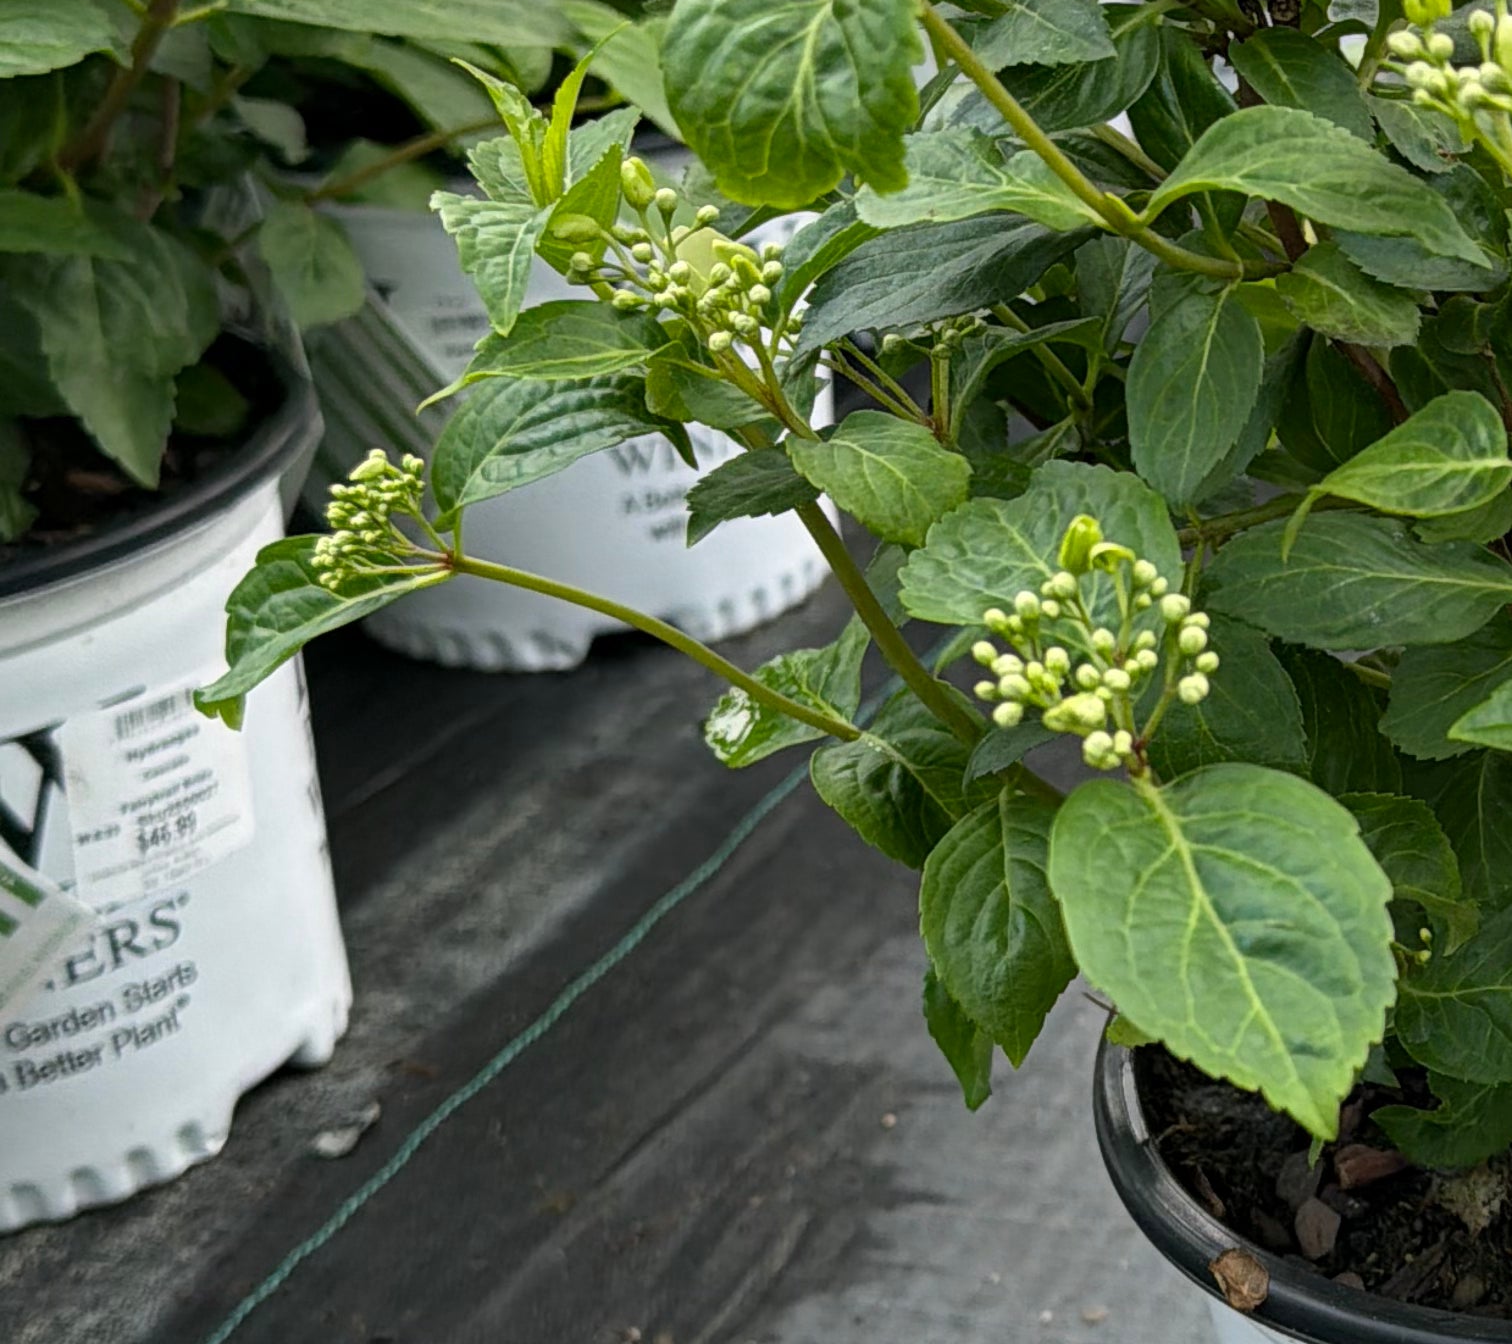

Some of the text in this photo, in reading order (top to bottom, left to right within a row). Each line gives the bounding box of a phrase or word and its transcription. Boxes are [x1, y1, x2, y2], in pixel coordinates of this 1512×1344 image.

[4, 959, 199, 1052] Garden Starts
[14, 1043, 104, 1091] Better
